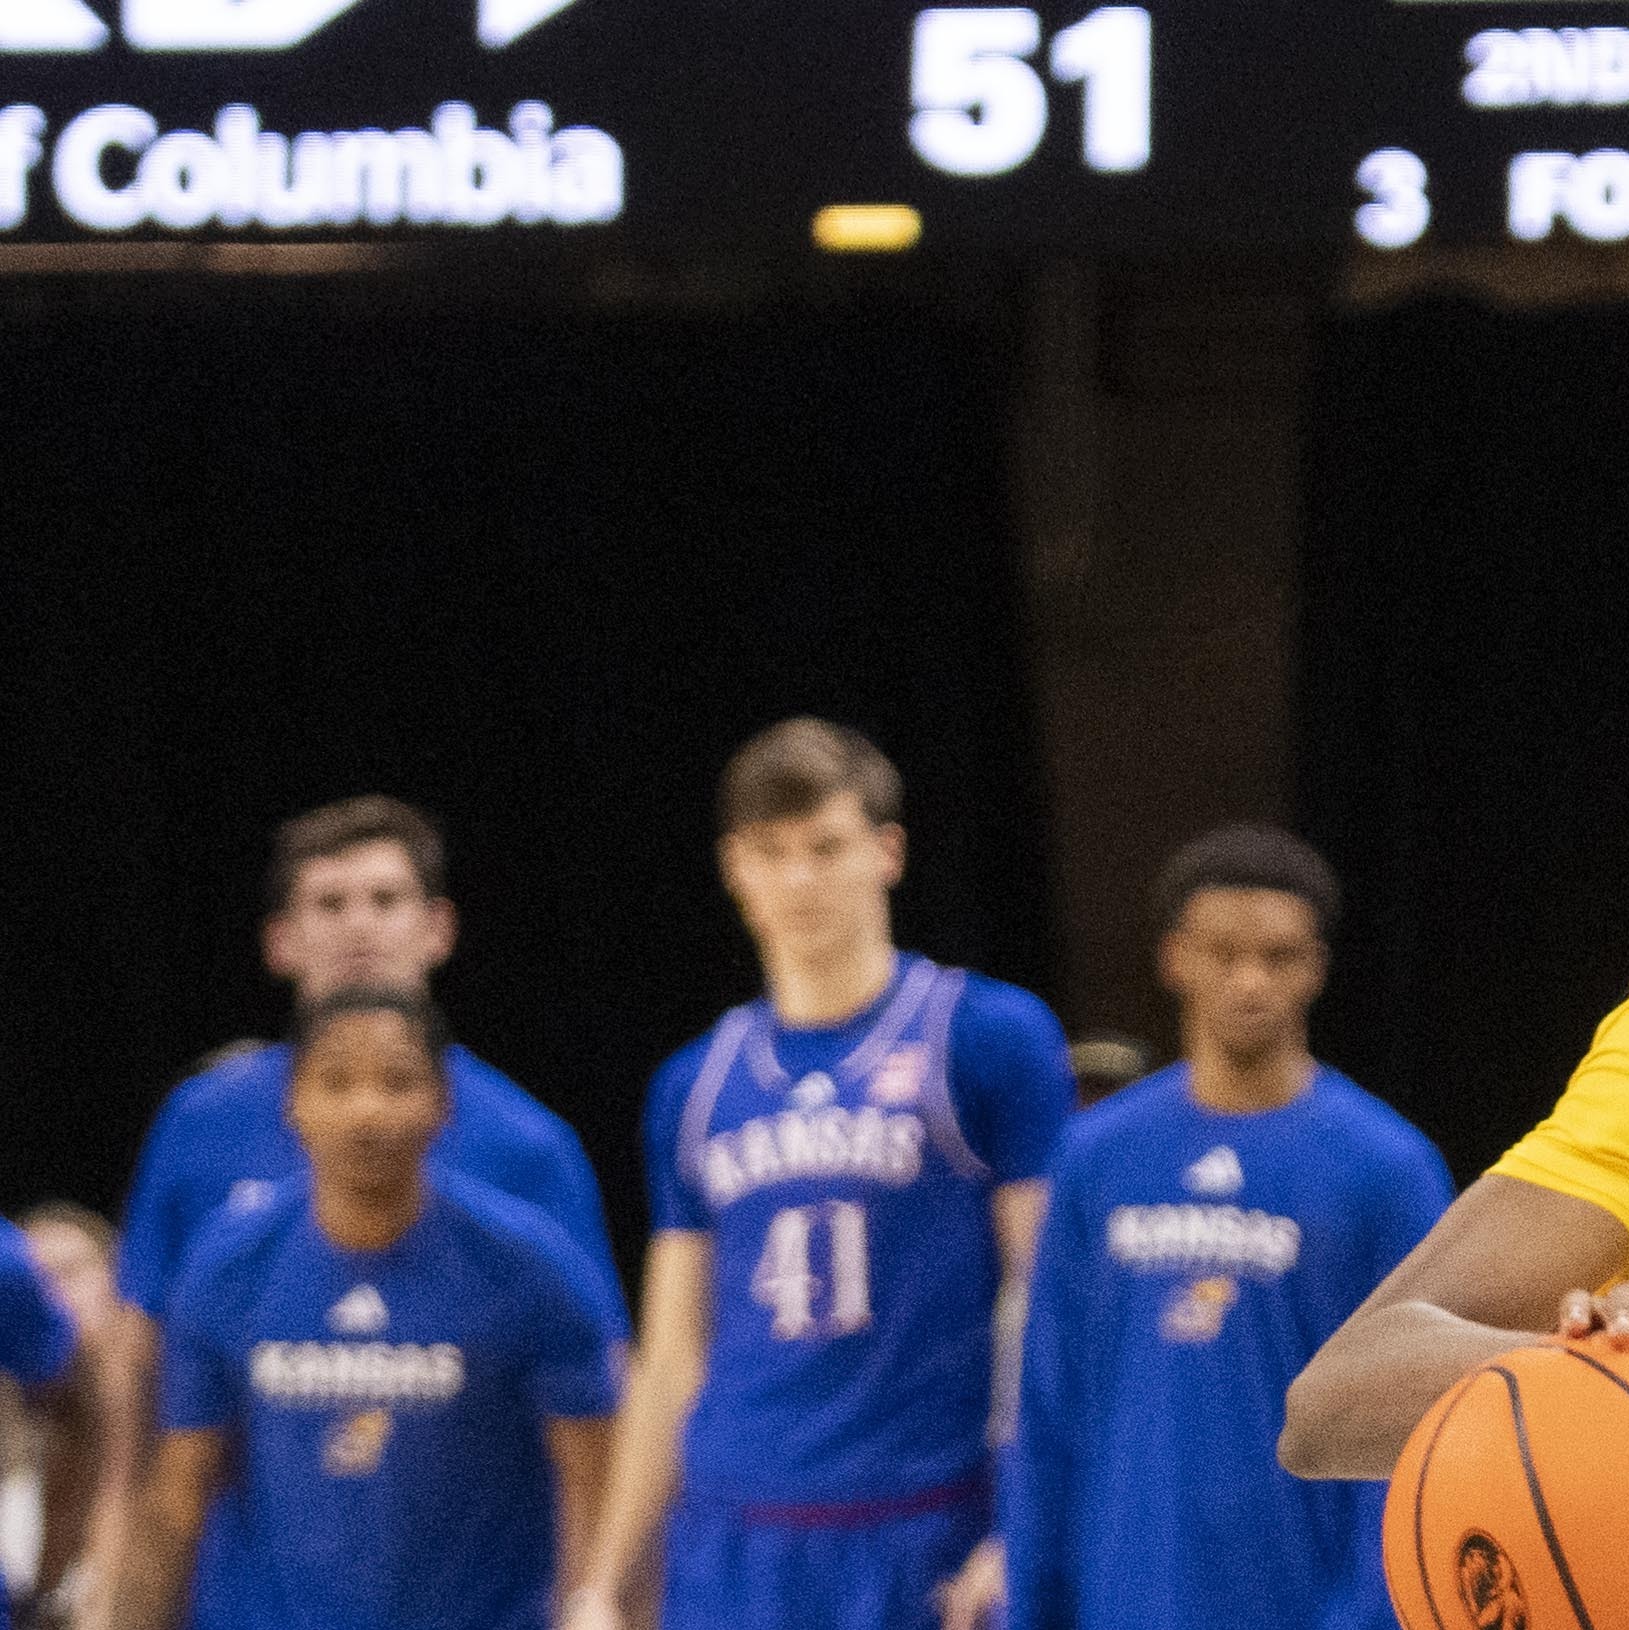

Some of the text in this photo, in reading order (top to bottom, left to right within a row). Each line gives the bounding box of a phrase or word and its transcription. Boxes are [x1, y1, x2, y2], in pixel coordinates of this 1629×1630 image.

[908, 4, 1155, 176] 51
[52, 98, 626, 232] Columbia
[1354, 147, 1431, 250] 3
[702, 1103, 928, 1206] KANSAS
[752, 1200, 873, 1340] 41
